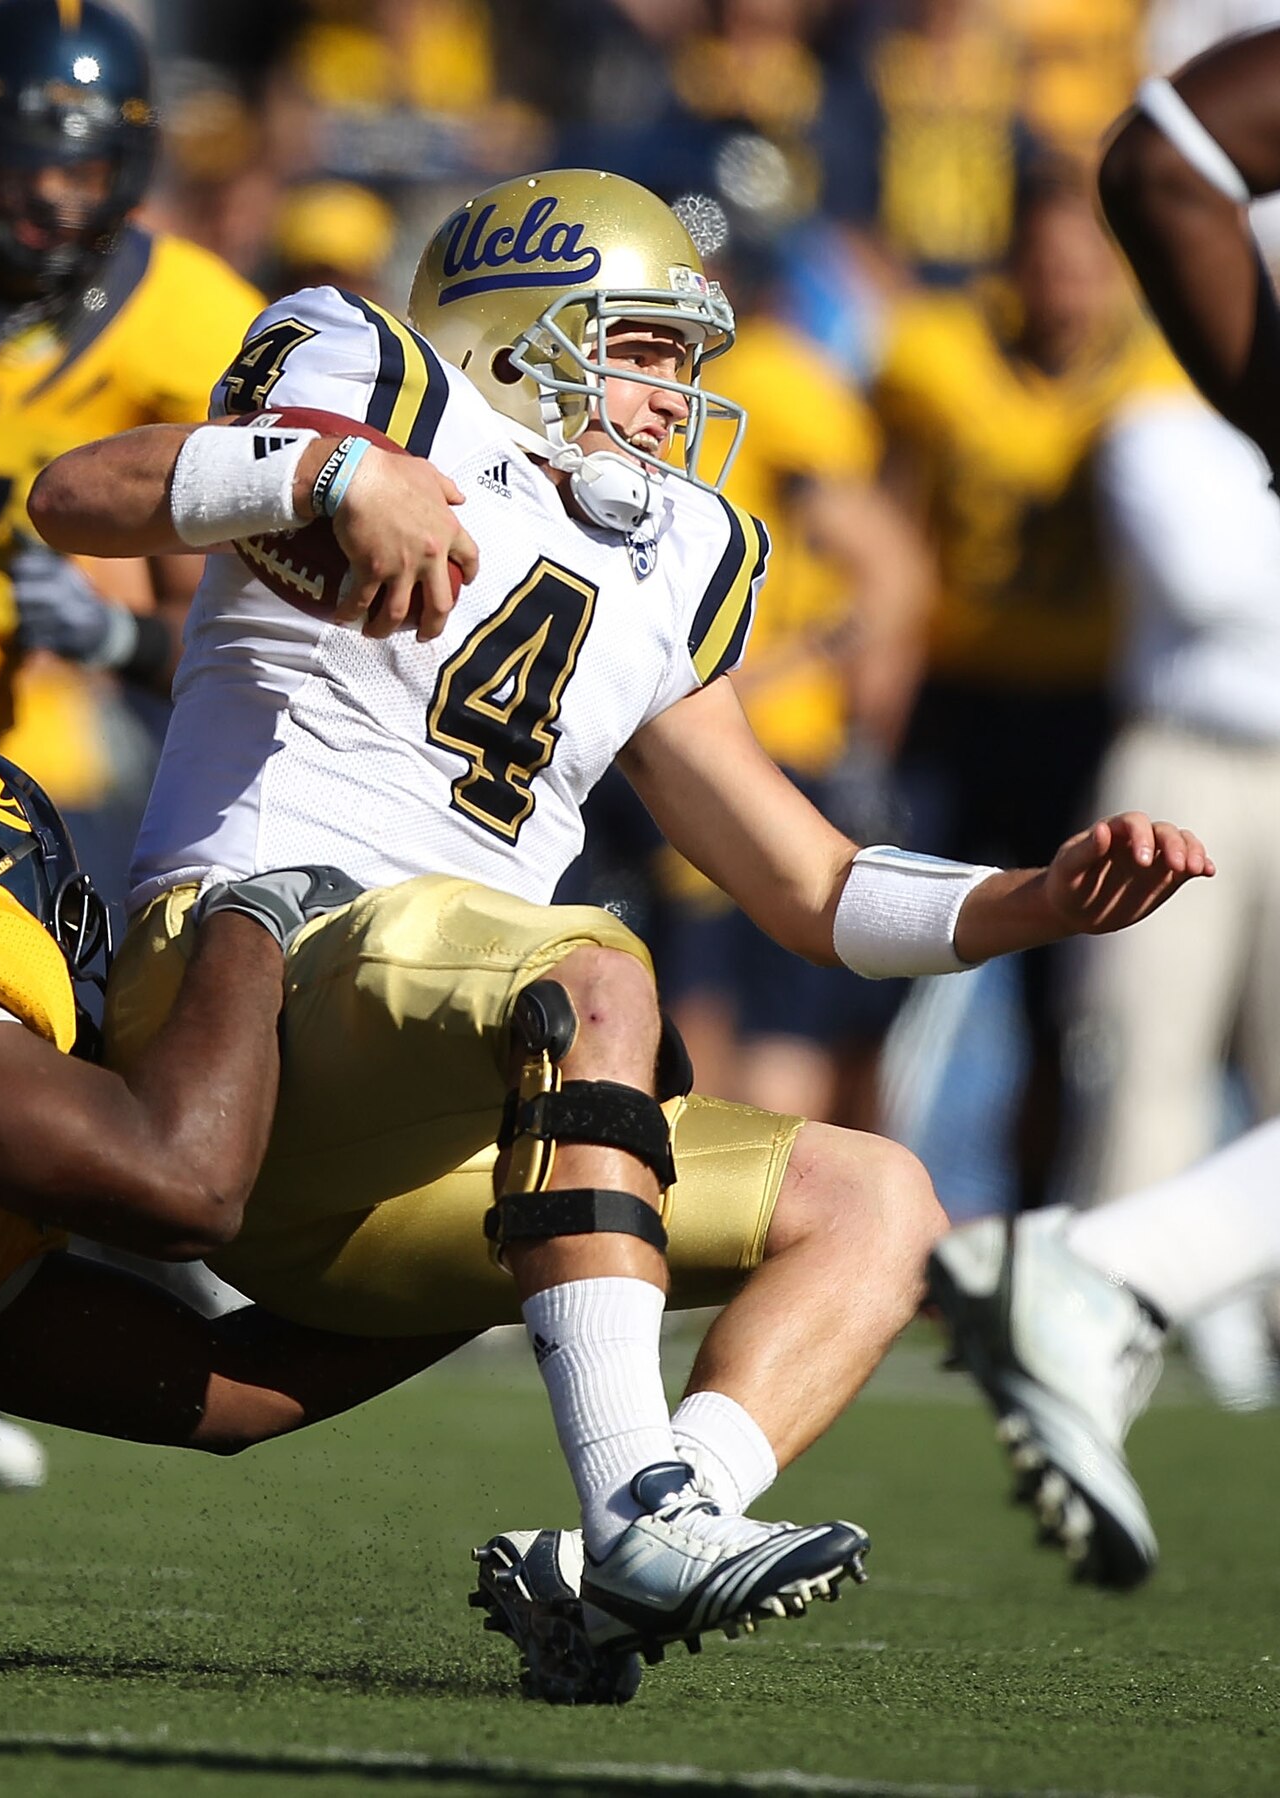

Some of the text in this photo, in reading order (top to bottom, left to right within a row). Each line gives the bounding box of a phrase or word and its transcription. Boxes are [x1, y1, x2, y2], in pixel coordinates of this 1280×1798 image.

[439, 197, 601, 292] Ucla
[221, 317, 321, 414] 4
[477, 475, 512, 499] adidas
[425, 554, 600, 847] 4
